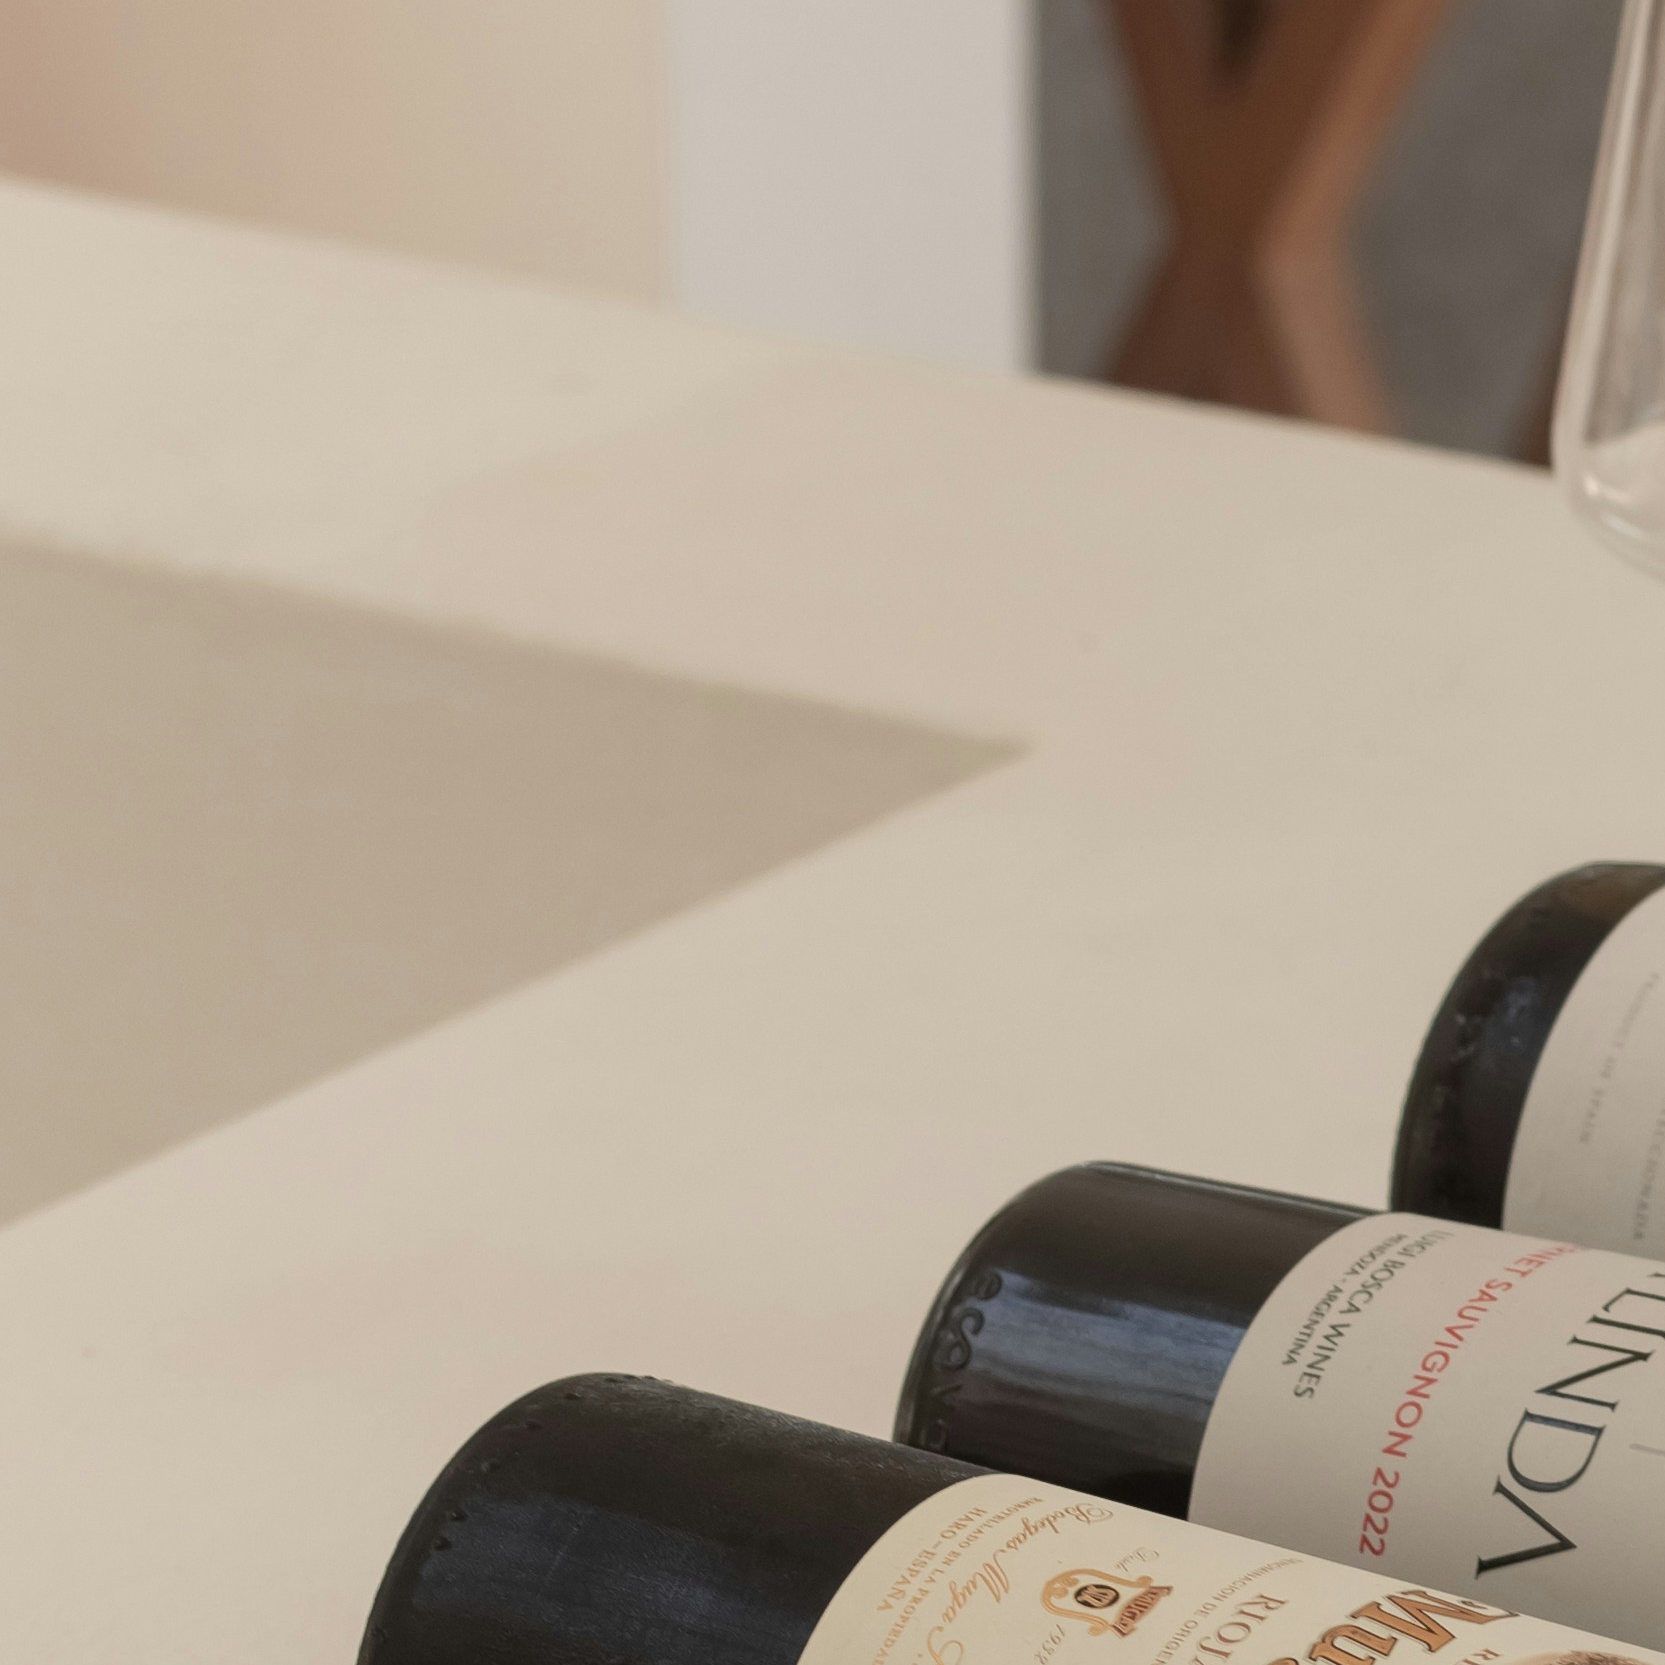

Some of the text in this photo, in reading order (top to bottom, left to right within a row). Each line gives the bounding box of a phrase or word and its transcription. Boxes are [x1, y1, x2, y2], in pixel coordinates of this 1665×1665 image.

[1344, 1232, 1409, 1277] MENDOZA
[1337, 1257, 1406, 1316] BOSCA
[1281, 1283, 1345, 1367] ARGENTINA
[1293, 1320, 1353, 1401] WINES
[1381, 1278, 1513, 1459] SAUVIGNON
[938, 1506, 989, 1542] HARO
[1005, 1502, 1114, 1551] Bodegas
[1359, 1466, 1400, 1557] 2022
[876, 1548, 938, 1613] ESPAÑA
[923, 1567, 946, 1586] LA
[940, 1550, 962, 1567] EN
[941, 1548, 1010, 1624] Muga
[1194, 1600, 1218, 1619] DE
